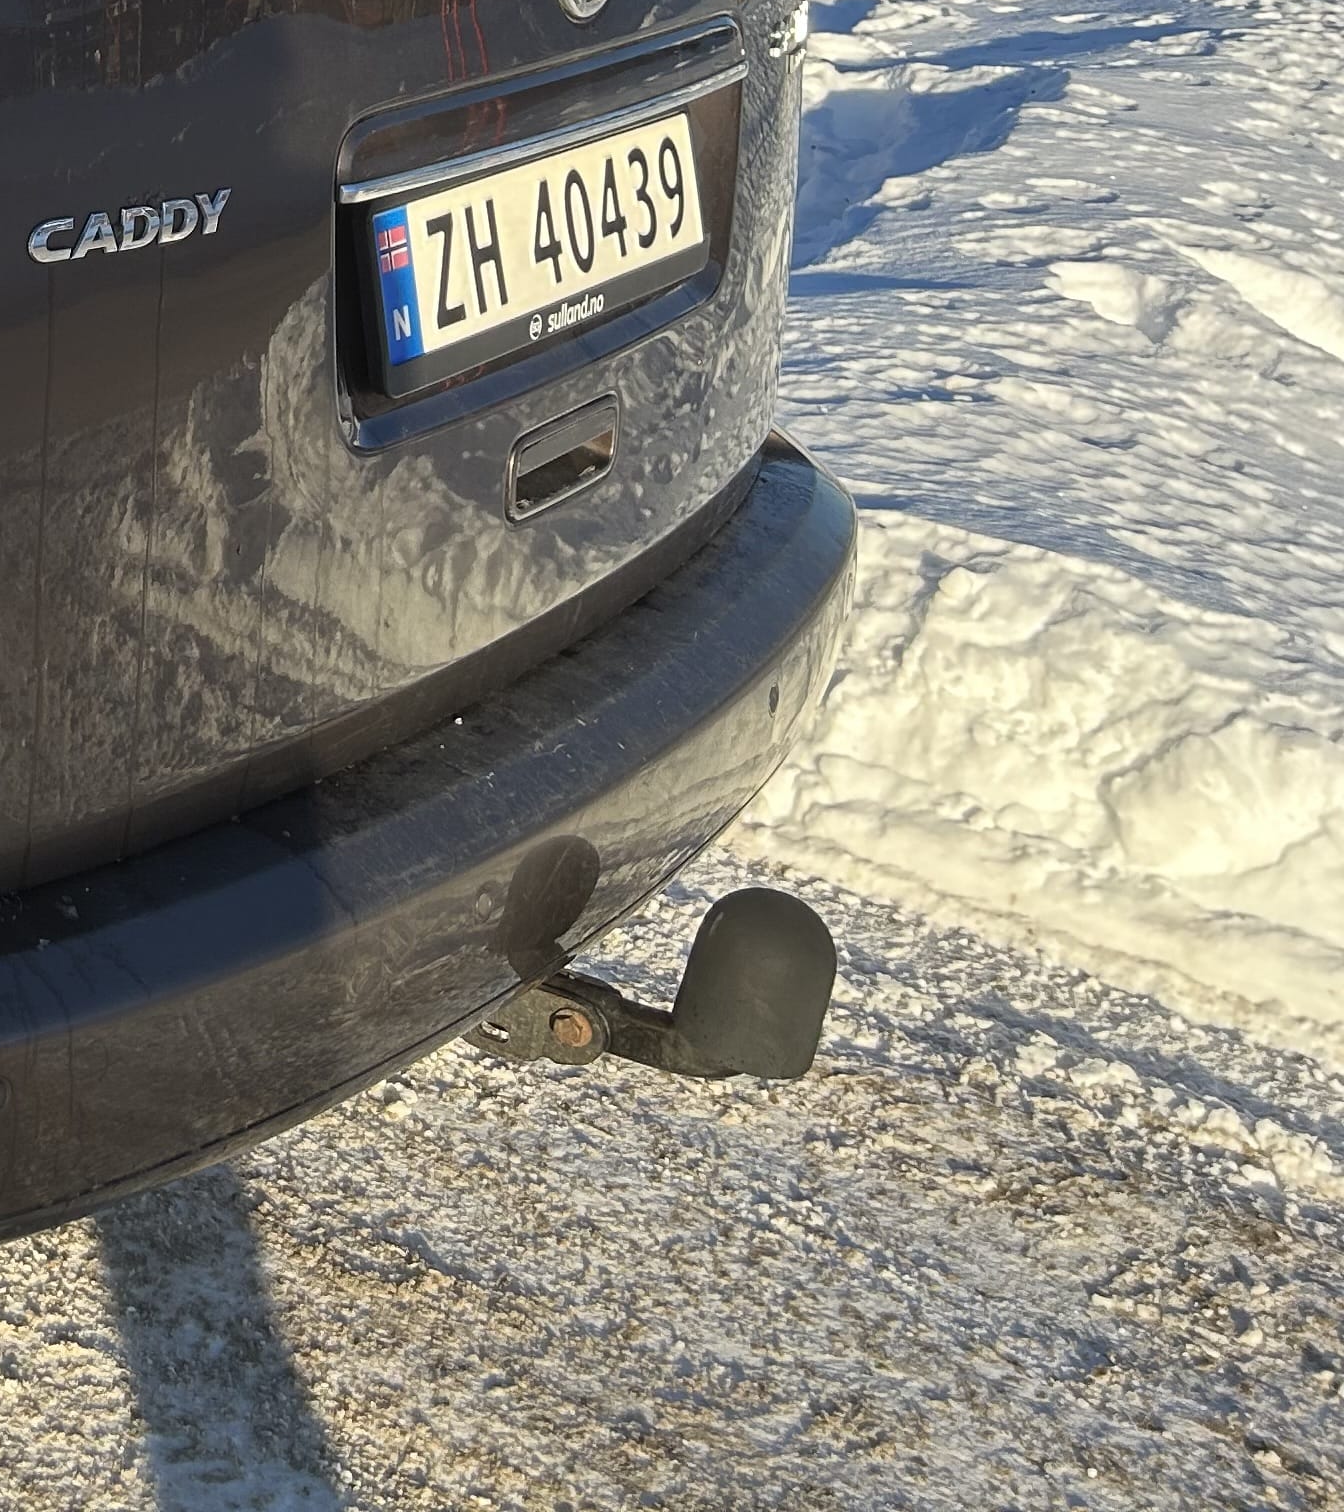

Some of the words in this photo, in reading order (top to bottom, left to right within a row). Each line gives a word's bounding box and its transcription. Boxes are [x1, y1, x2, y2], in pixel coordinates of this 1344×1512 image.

[28, 188, 232, 262] CADDY
[425, 198, 509, 330] ZH
[533, 136, 686, 284] 40439
[393, 305, 412, 341] N
[547, 293, 604, 333] sulland.no
